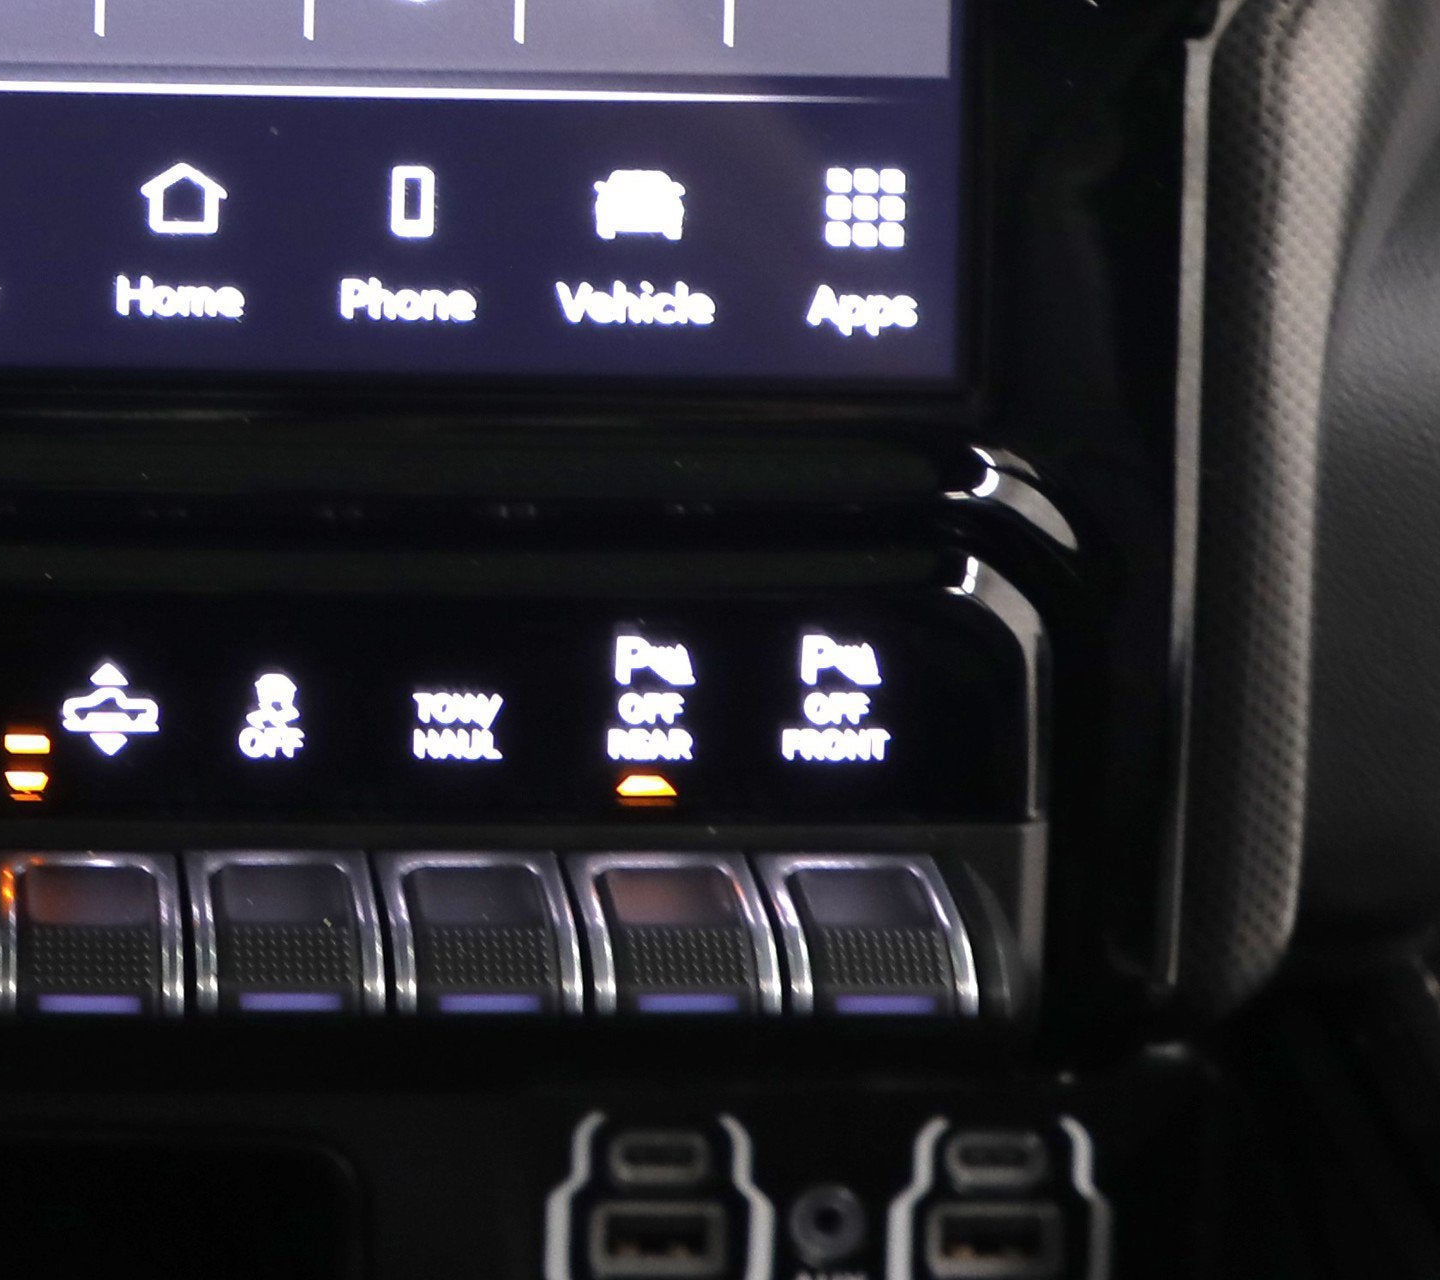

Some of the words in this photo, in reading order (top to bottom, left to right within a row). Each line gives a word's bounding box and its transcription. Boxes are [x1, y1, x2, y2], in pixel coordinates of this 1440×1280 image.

[115, 276, 245, 320] Home
[340, 277, 478, 323] Phone
[555, 280, 716, 328] Vehicle
[806, 284, 919, 336] Apps
[618, 693, 686, 726] OFF
[803, 693, 871, 727] OFF
[238, 727, 306, 761] OFF
[412, 728, 504, 762] HAUL
[606, 728, 694, 762] REAR
[780, 728, 891, 762] FRONT
